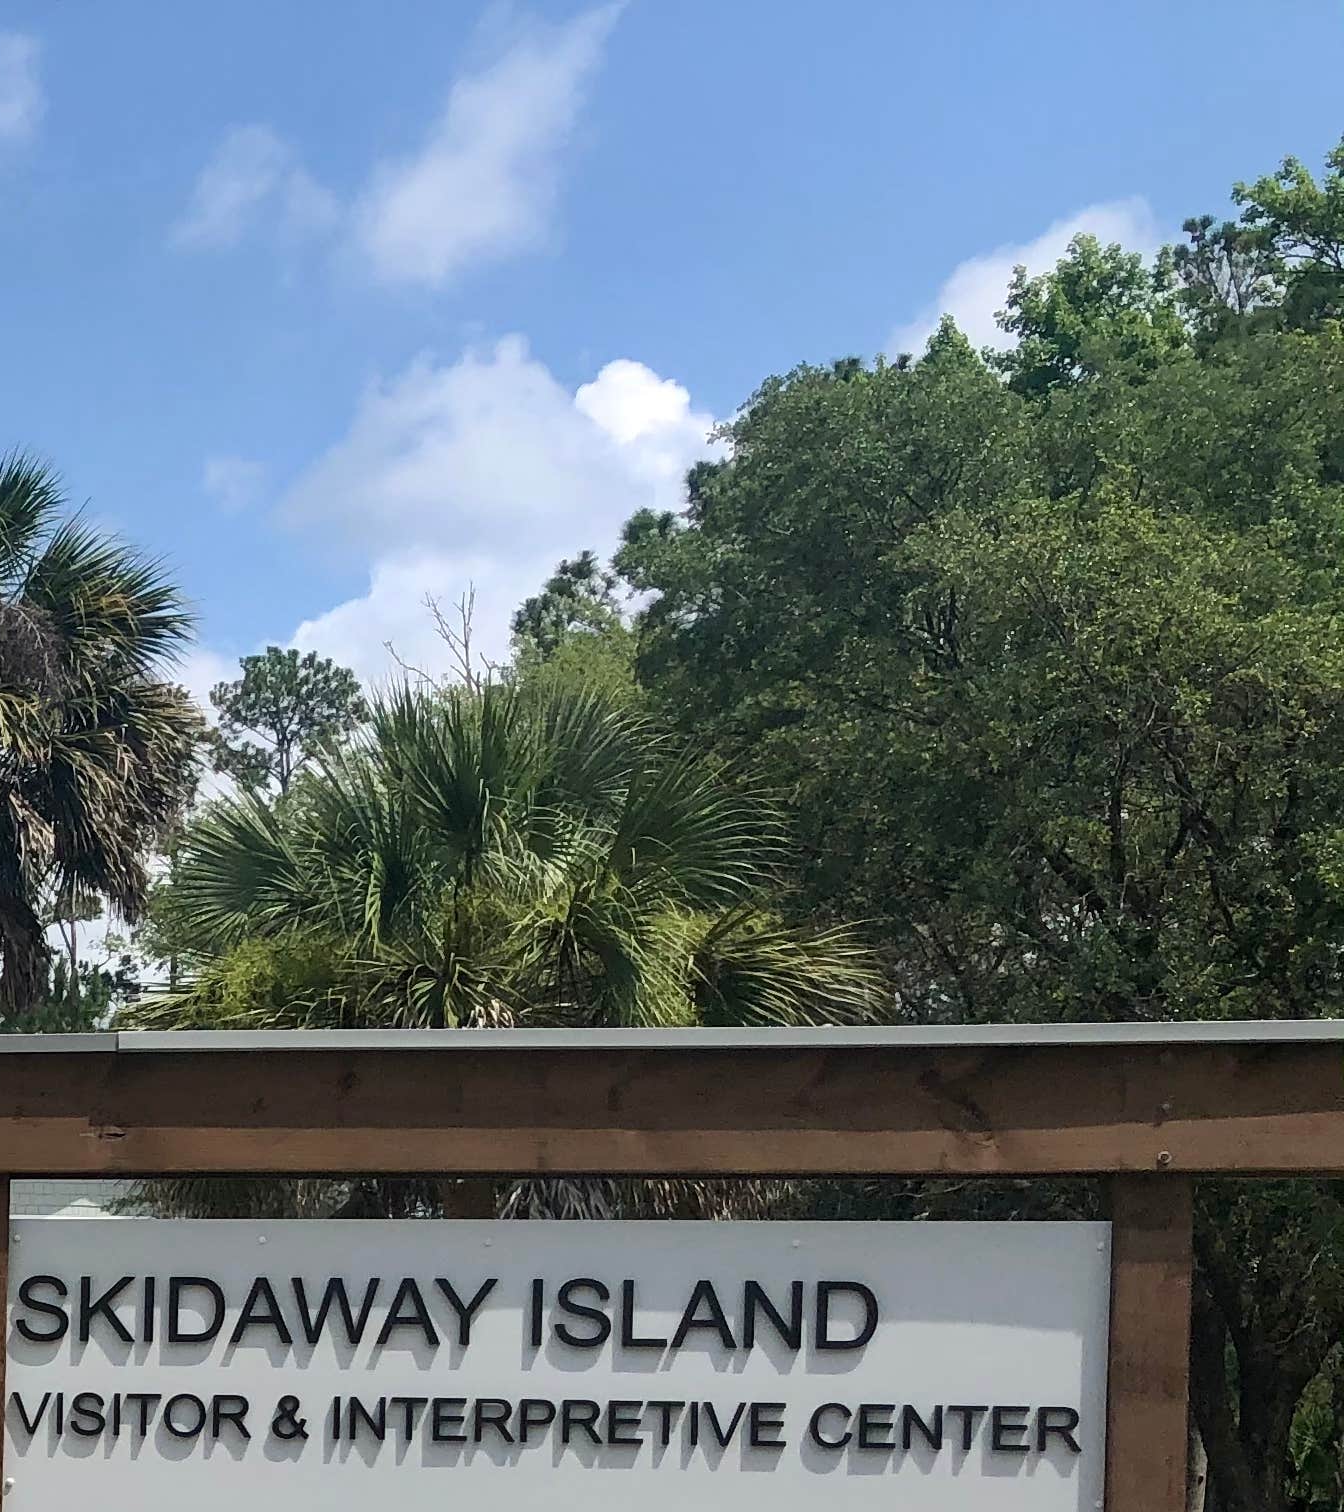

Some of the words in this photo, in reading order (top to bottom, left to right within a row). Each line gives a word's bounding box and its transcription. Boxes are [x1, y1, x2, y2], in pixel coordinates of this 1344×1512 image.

[16, 1274, 499, 1347] SKIDAWAY
[531, 1278, 879, 1352] ISLAND
[11, 1391, 252, 1441] VISITOR
[271, 1394, 310, 1441] &
[332, 1396, 787, 1450] INTERPRETIVE
[808, 1402, 1082, 1454] CENTER
